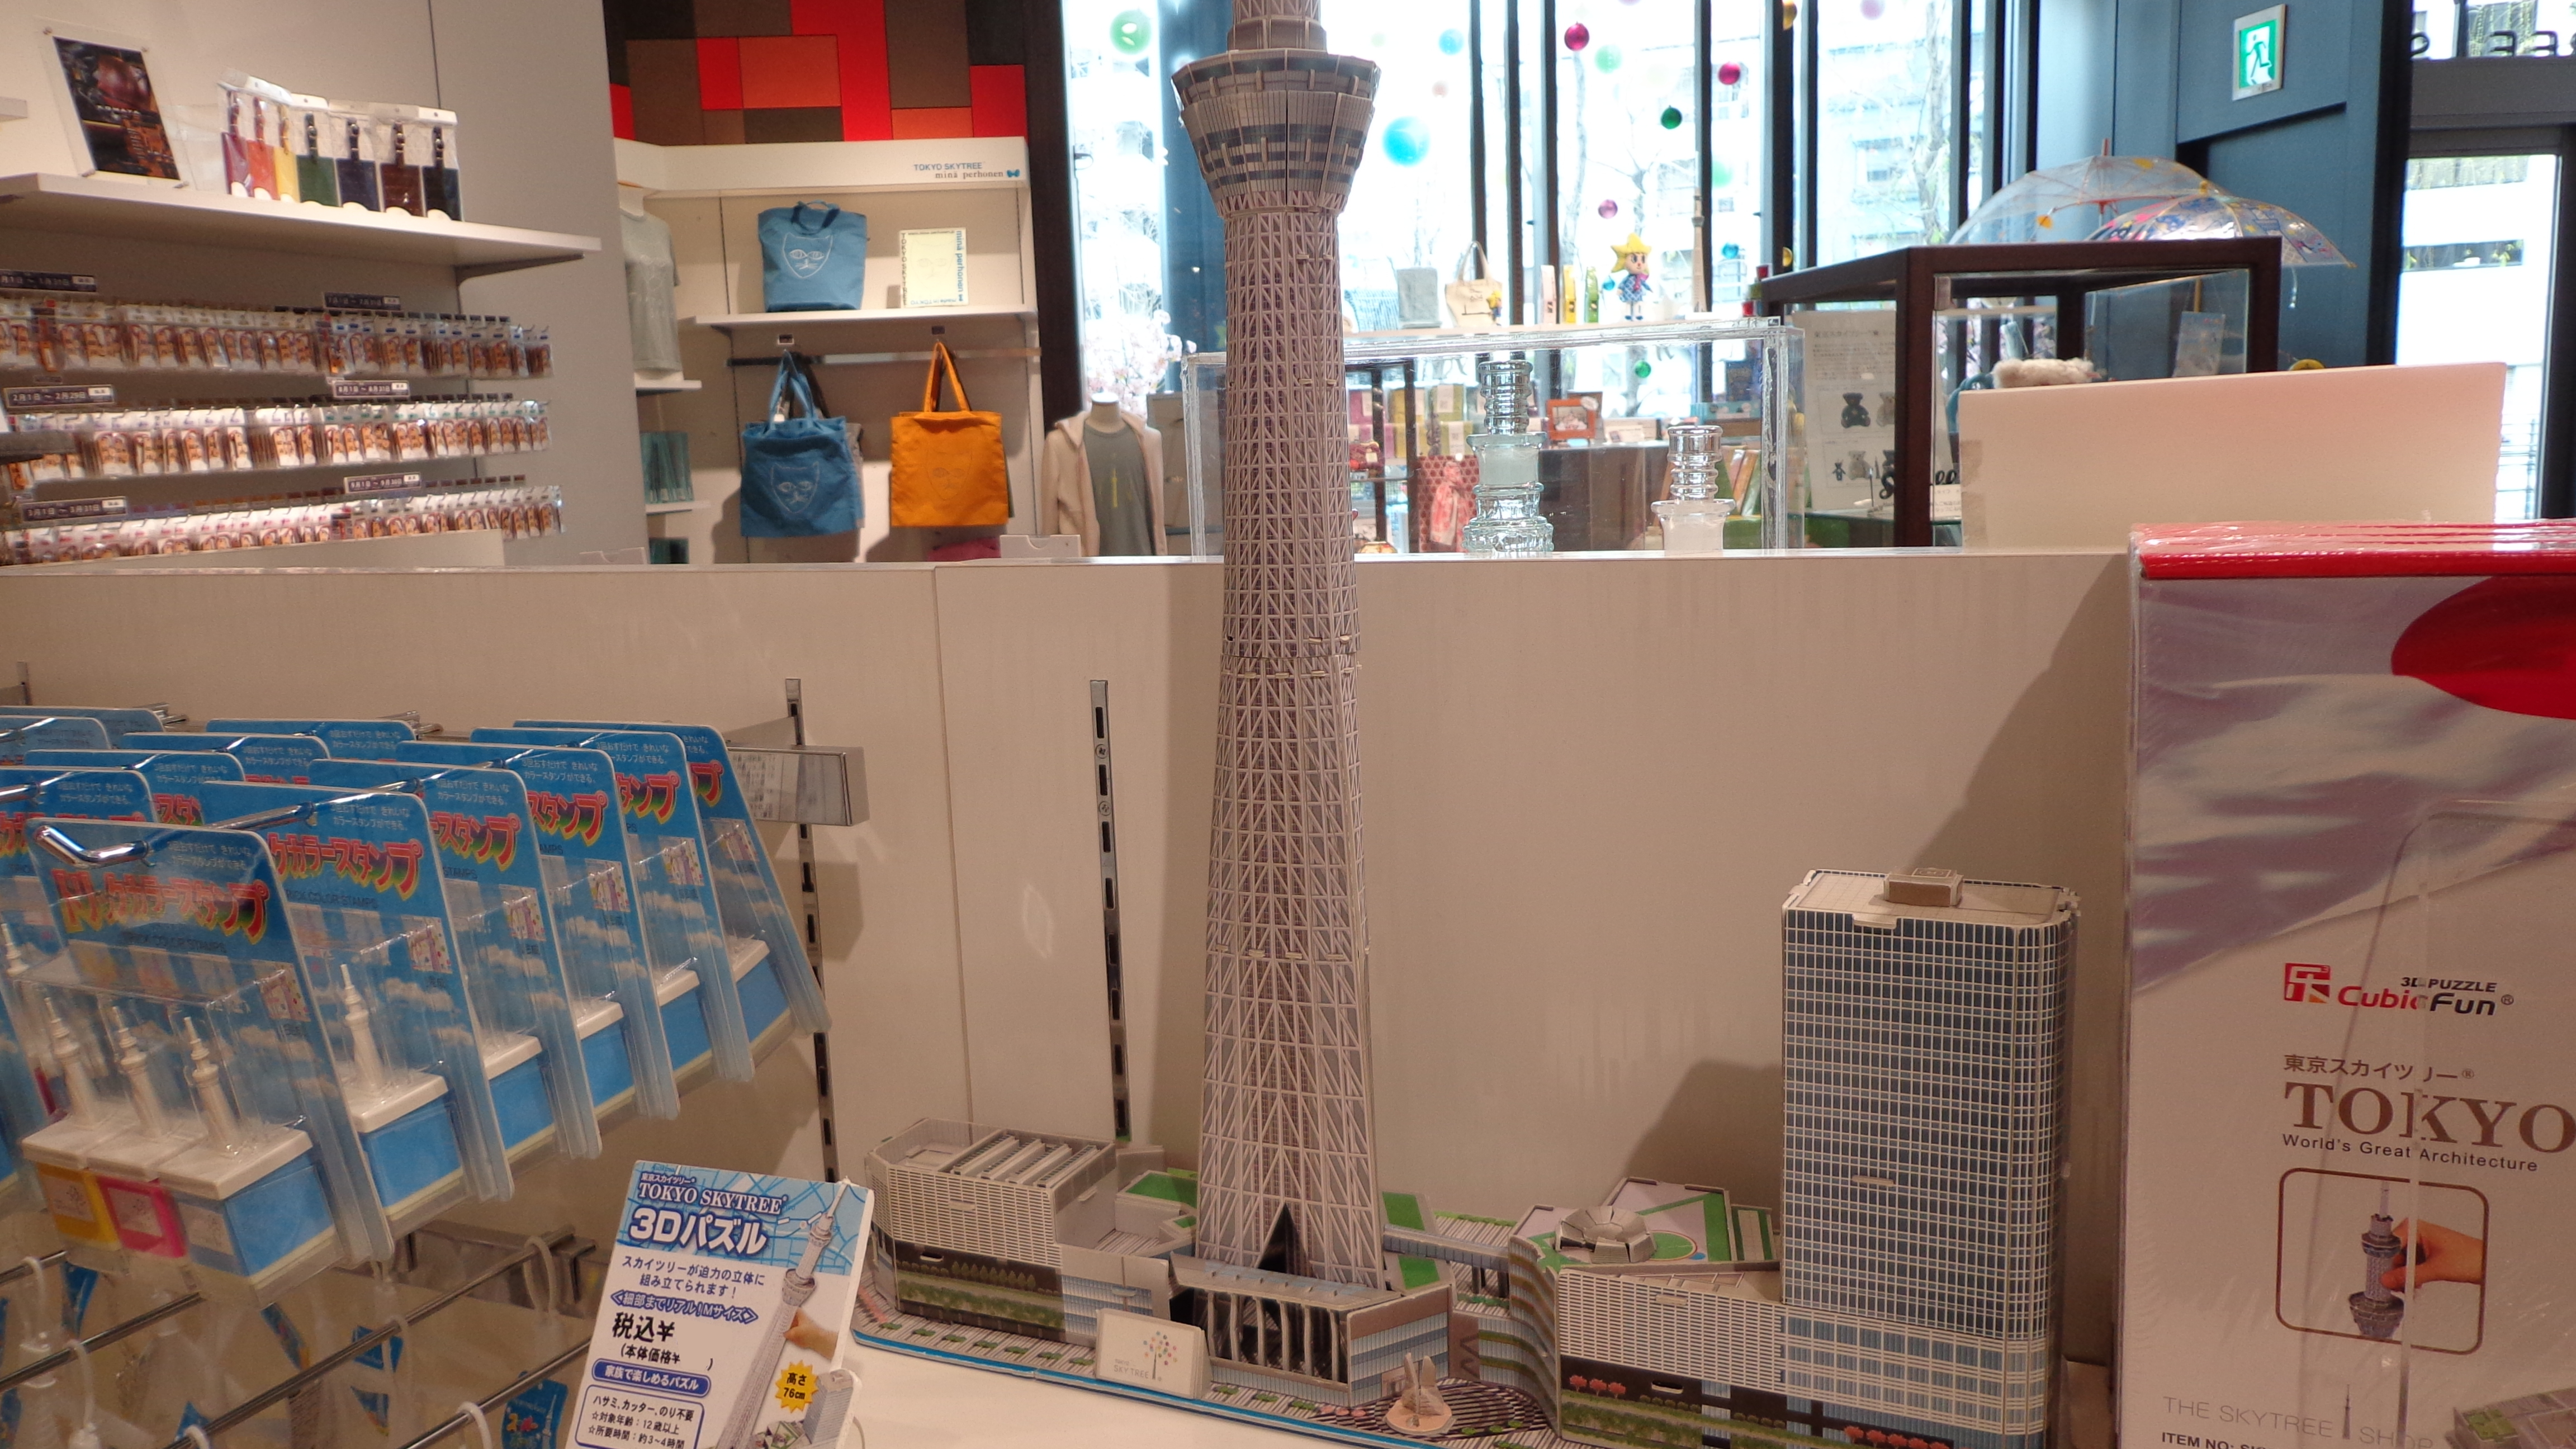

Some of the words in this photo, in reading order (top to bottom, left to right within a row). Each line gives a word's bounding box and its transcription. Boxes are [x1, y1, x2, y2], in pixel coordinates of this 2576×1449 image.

[963, 170, 1004, 179] perhonen
[955, 253, 965, 292] perhonen
[2428, 978, 2497, 993] PUZZLE
[2284, 1081, 2576, 1154] TOKYO
[2283, 1133, 2351, 1153] World's
[2359, 1141, 2411, 1158] Great
[2419, 1149, 2538, 1172] Architecture
[638, 1182, 698, 1204] TOKYO
[699, 1189, 783, 1215] SKYTREE
[629, 1208, 768, 1255] 3Dパズル
[622, 1256, 766, 1286] スカイツリーが迫力の立体に
[604, 1365, 699, 1391] 家族で楽しめるパズル
[787, 1372, 807, 1386] 高さ
[784, 1387, 806, 1400] 76cm
[593, 1396, 695, 1422] ハサミ、カッター、のり不要
[2163, 1396, 2210, 1419] THE
[2219, 1405, 2334, 1438] SKYTREE
[2162, 1432, 2200, 1449] ITEM
